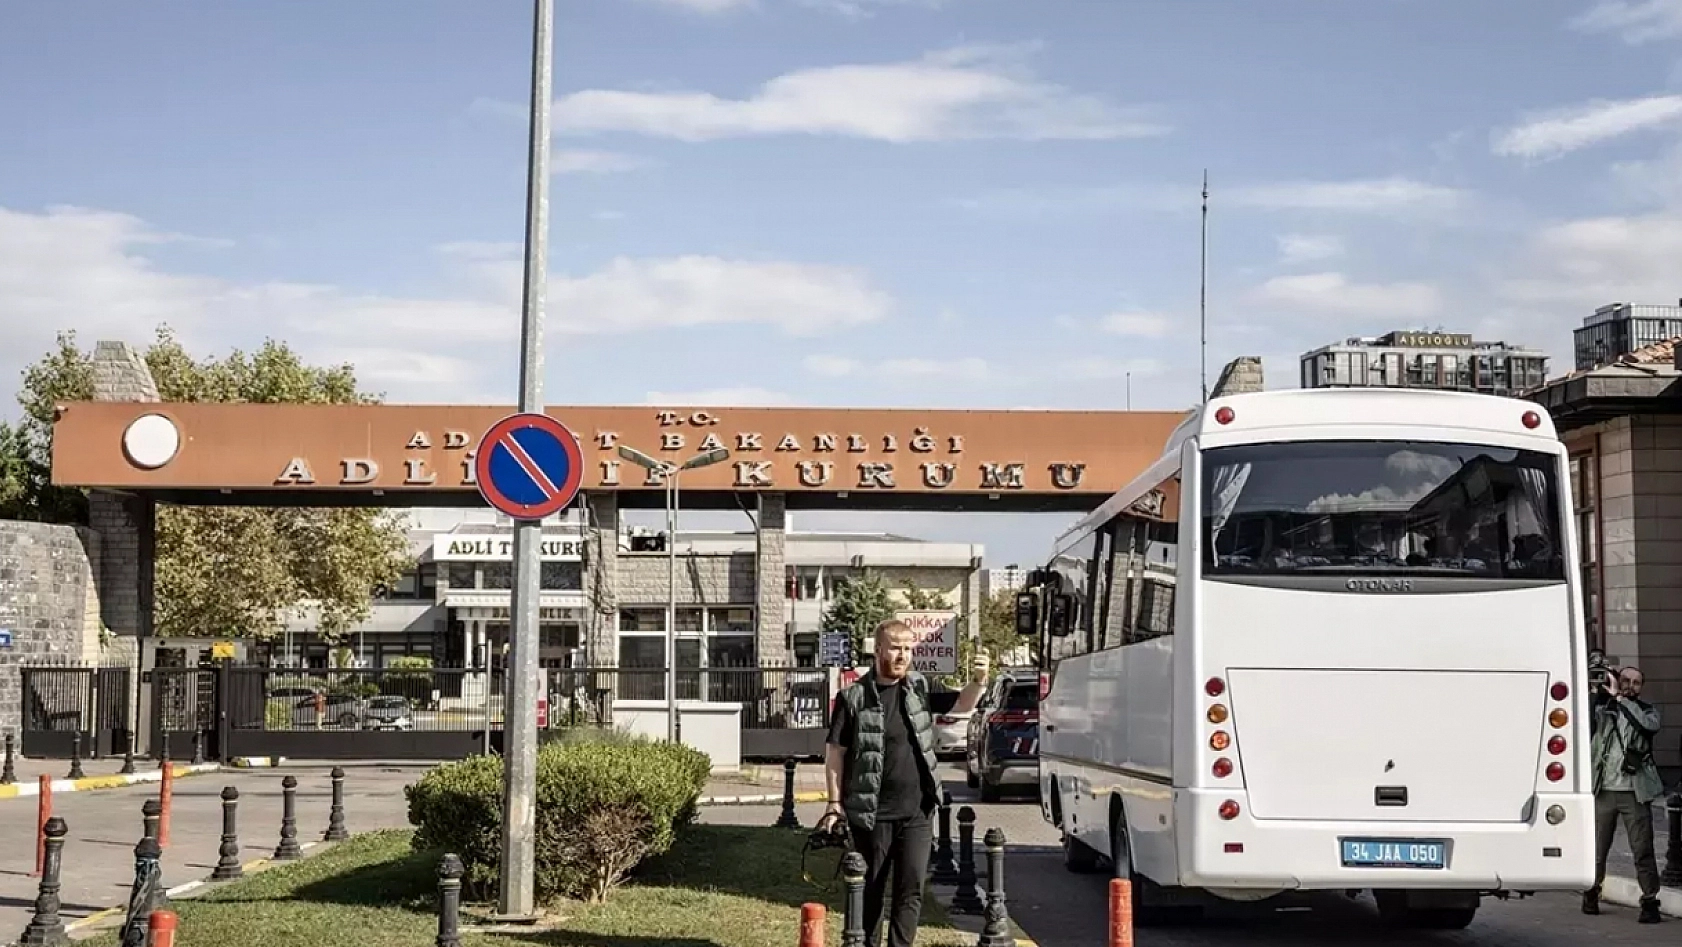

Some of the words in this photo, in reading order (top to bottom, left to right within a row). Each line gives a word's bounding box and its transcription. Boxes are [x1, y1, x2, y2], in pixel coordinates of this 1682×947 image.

[656, 410, 720, 427] T.C.
[660, 427, 966, 452] BAKANLIĞI
[732, 460, 1086, 488] KURUMU
[448, 537, 493, 555] ADLİ
[1351, 843, 1369, 860] 34
[1375, 844, 1401, 861] JAA
[1409, 844, 1437, 862] 050
